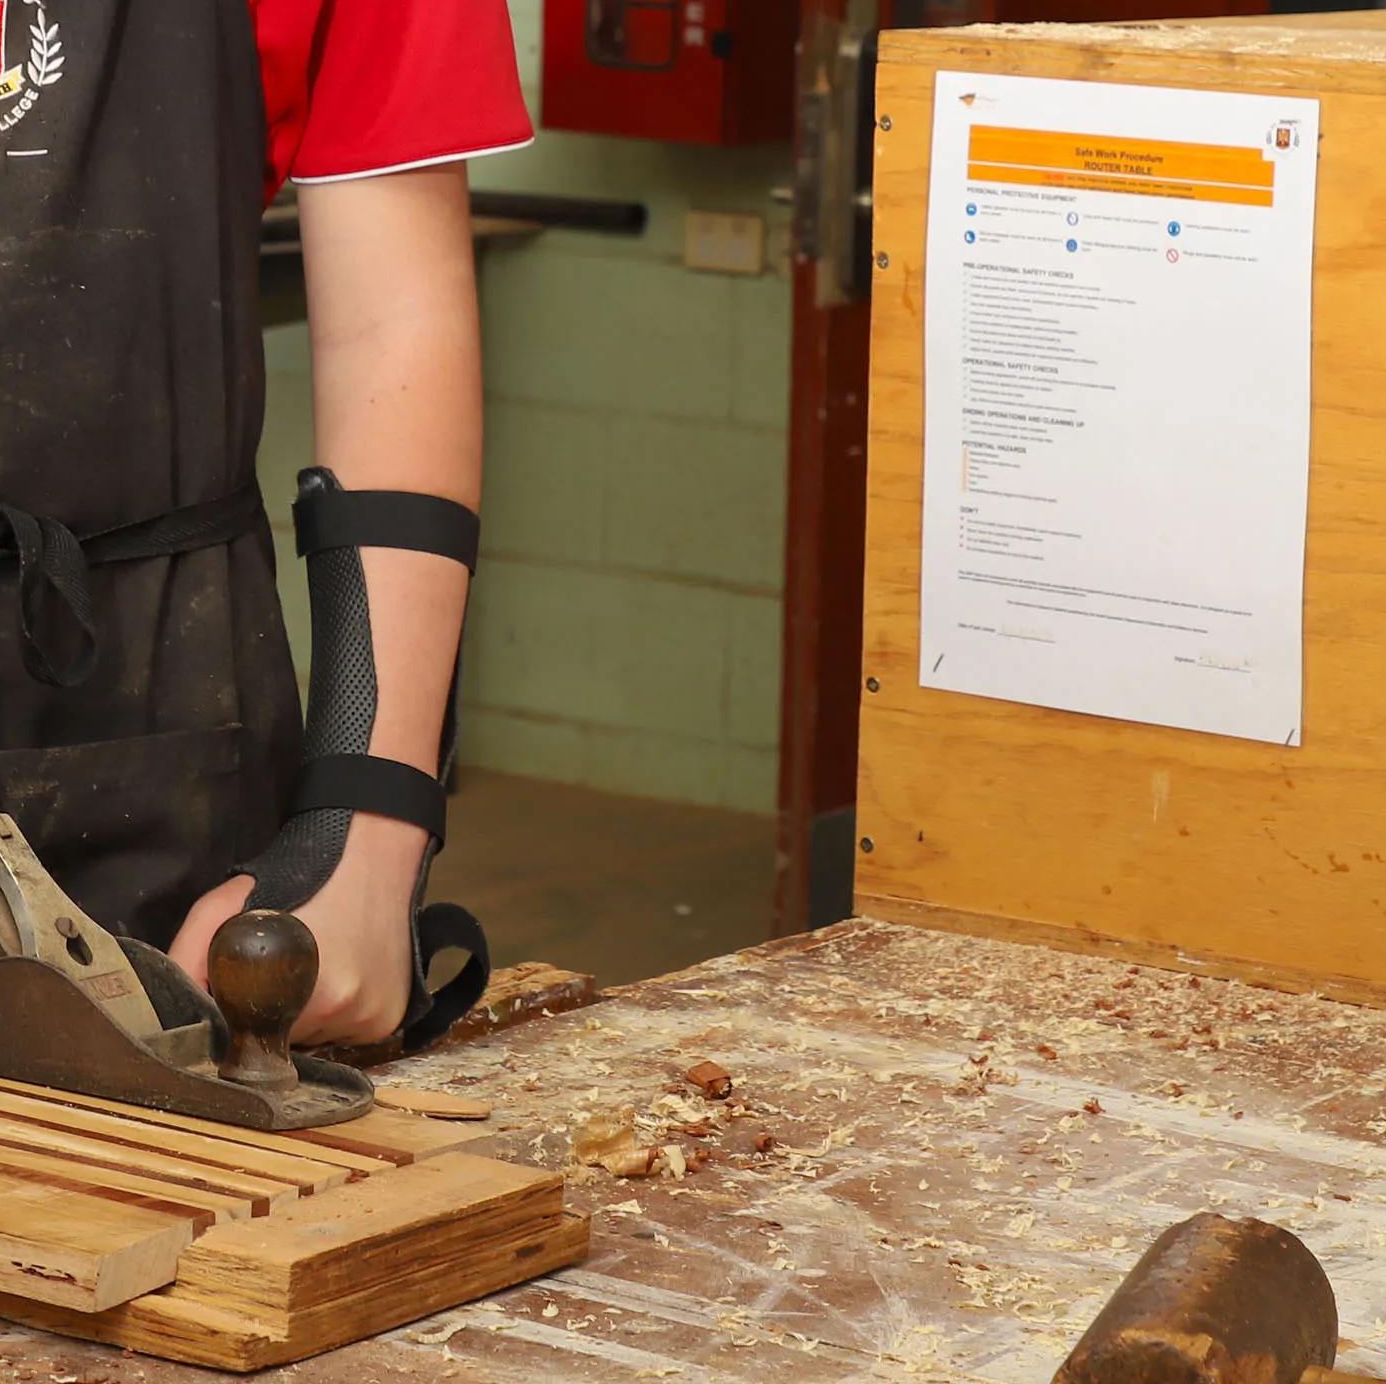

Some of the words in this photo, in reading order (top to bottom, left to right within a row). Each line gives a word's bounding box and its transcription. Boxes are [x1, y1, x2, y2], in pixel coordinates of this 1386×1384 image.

[1075, 147, 1093, 158] Safe
[1096, 149, 1118, 159] Work
[1121, 153, 1164, 164] Procedure
[1084, 161, 1121, 172] ROUTER
[1124, 164, 1153, 176] TABLE
